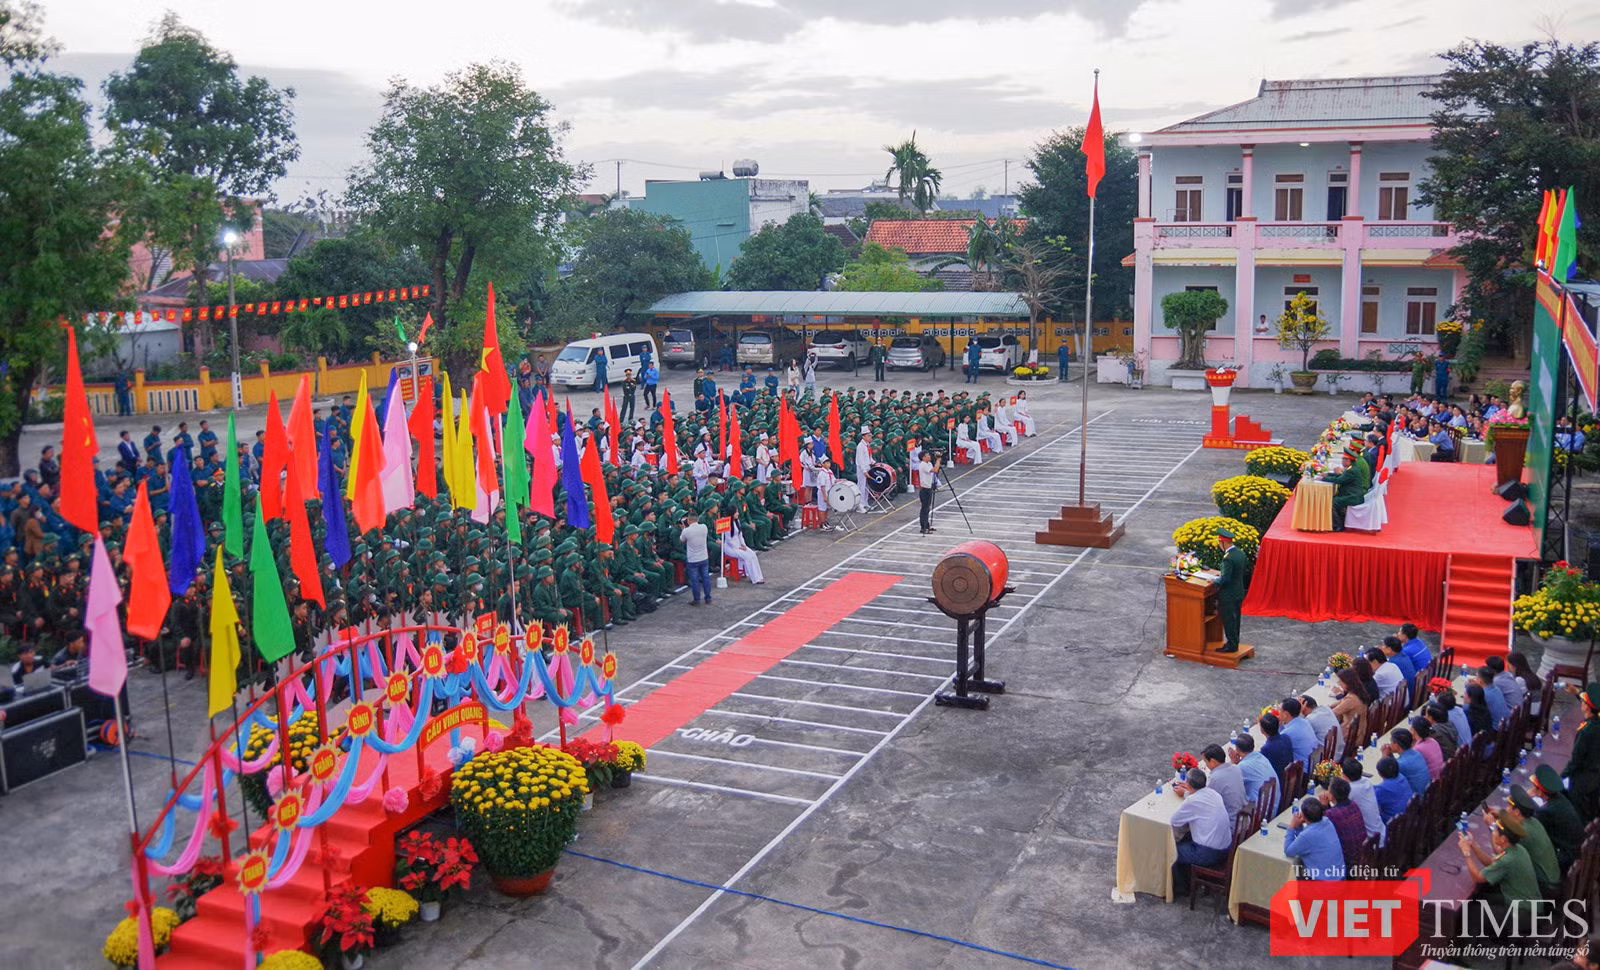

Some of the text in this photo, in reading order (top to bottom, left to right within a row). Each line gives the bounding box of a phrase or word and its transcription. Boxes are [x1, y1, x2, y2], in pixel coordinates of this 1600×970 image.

[352, 711, 370, 730] BÌNH
[443, 710, 460, 730] VINH
[461, 706, 483, 722] QUANG
